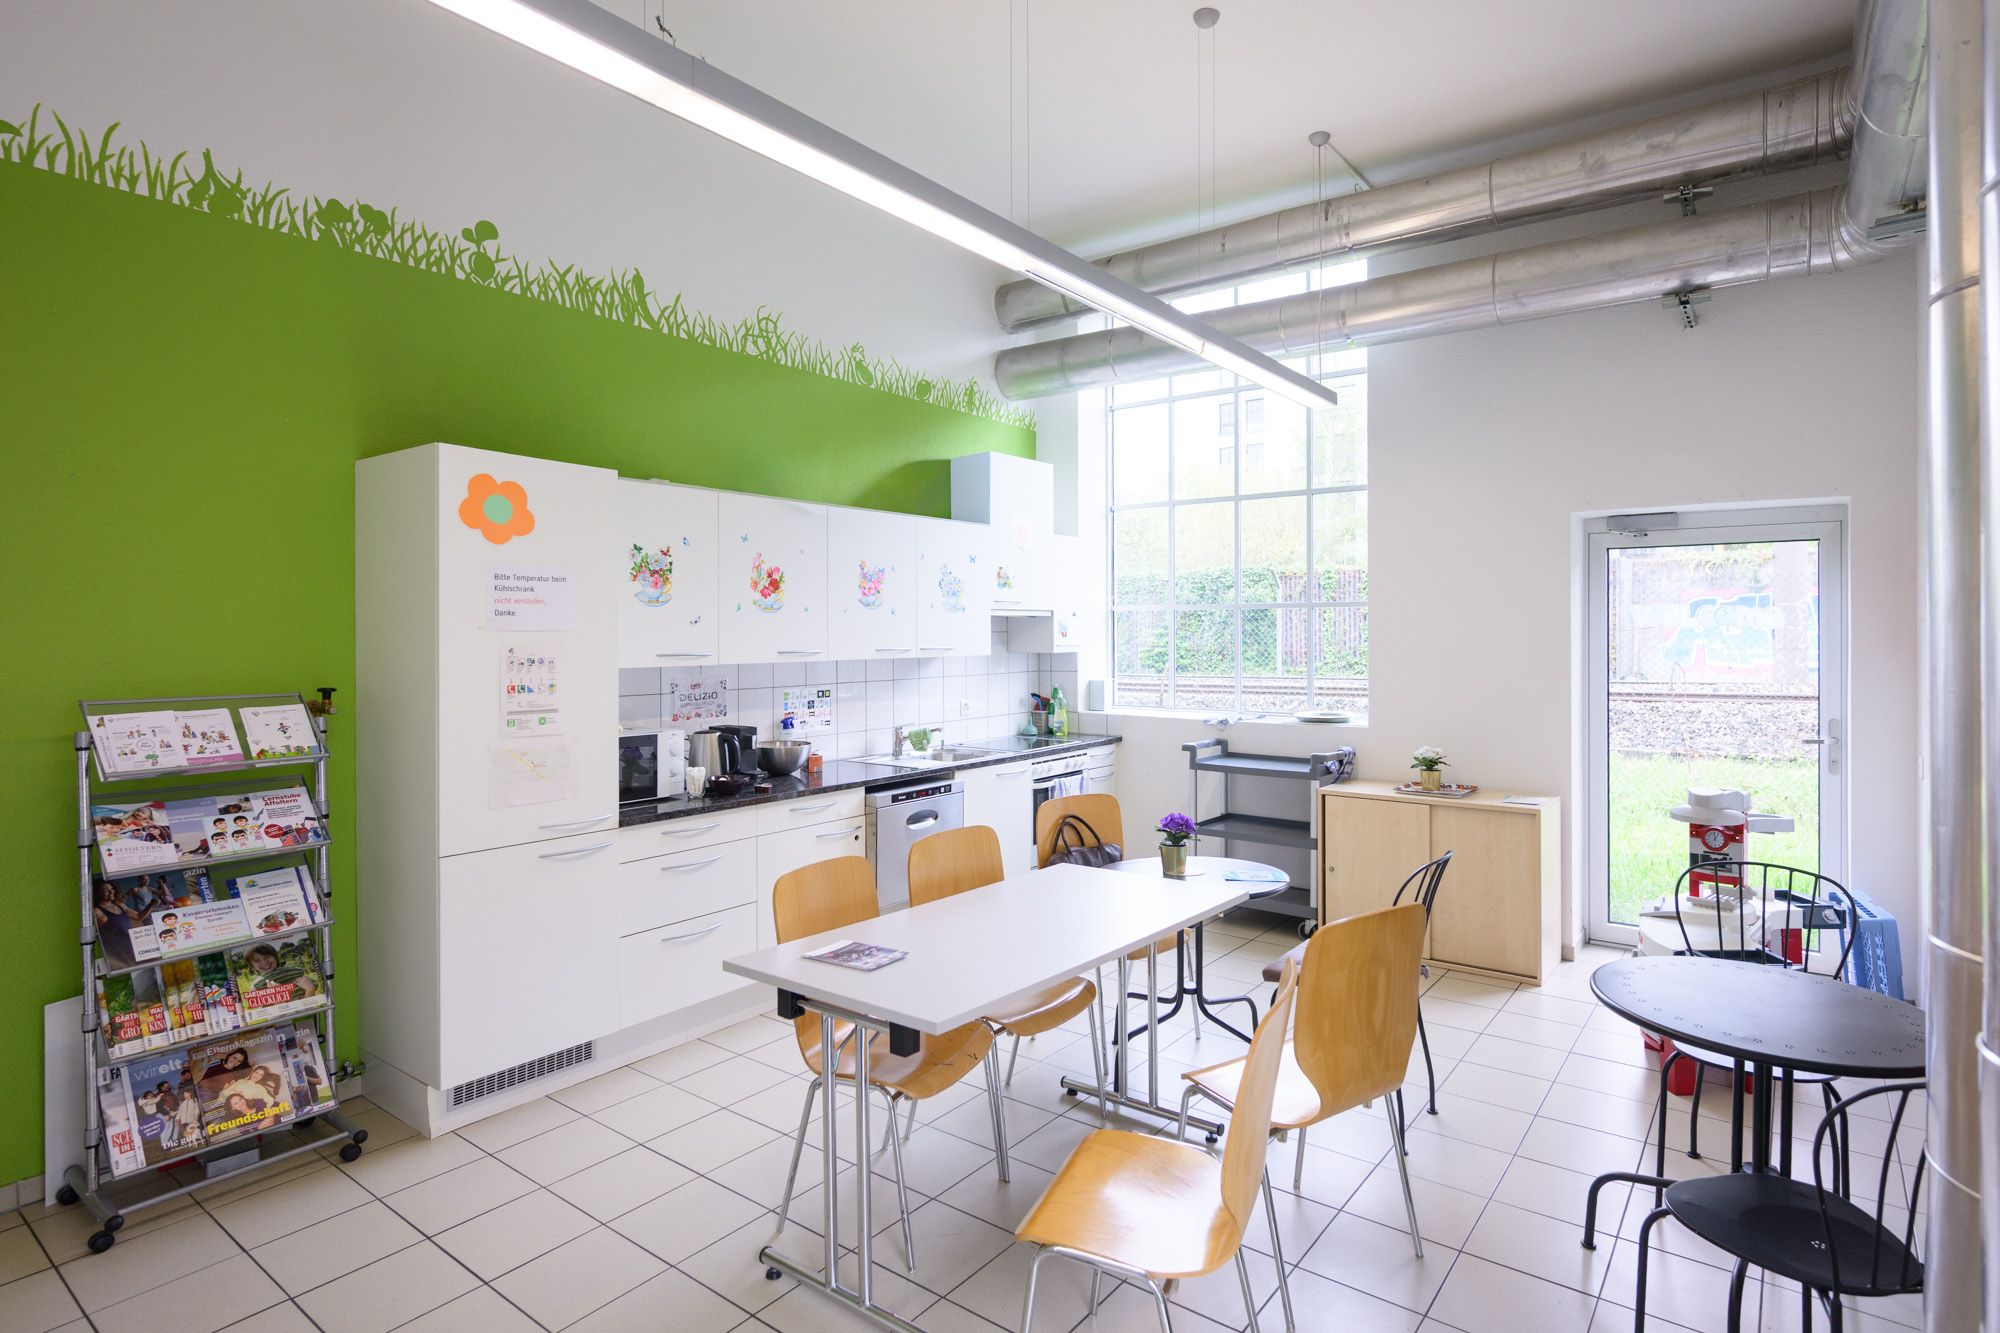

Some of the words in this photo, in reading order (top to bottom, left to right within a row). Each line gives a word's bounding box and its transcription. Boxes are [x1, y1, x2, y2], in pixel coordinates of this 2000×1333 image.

[493, 573, 511, 582] Bitte
[513, 574, 550, 583] Temperatur
[551, 575, 567, 583] beim
[493, 584, 535, 593] Kühlschrank
[494, 609, 518, 617] Danke.
[679, 691, 718, 702] DELIZIO
[262, 793, 302, 802] Lernstube
[264, 798, 298, 807] Affoltern
[207, 1101, 291, 1136] Freundschaft
